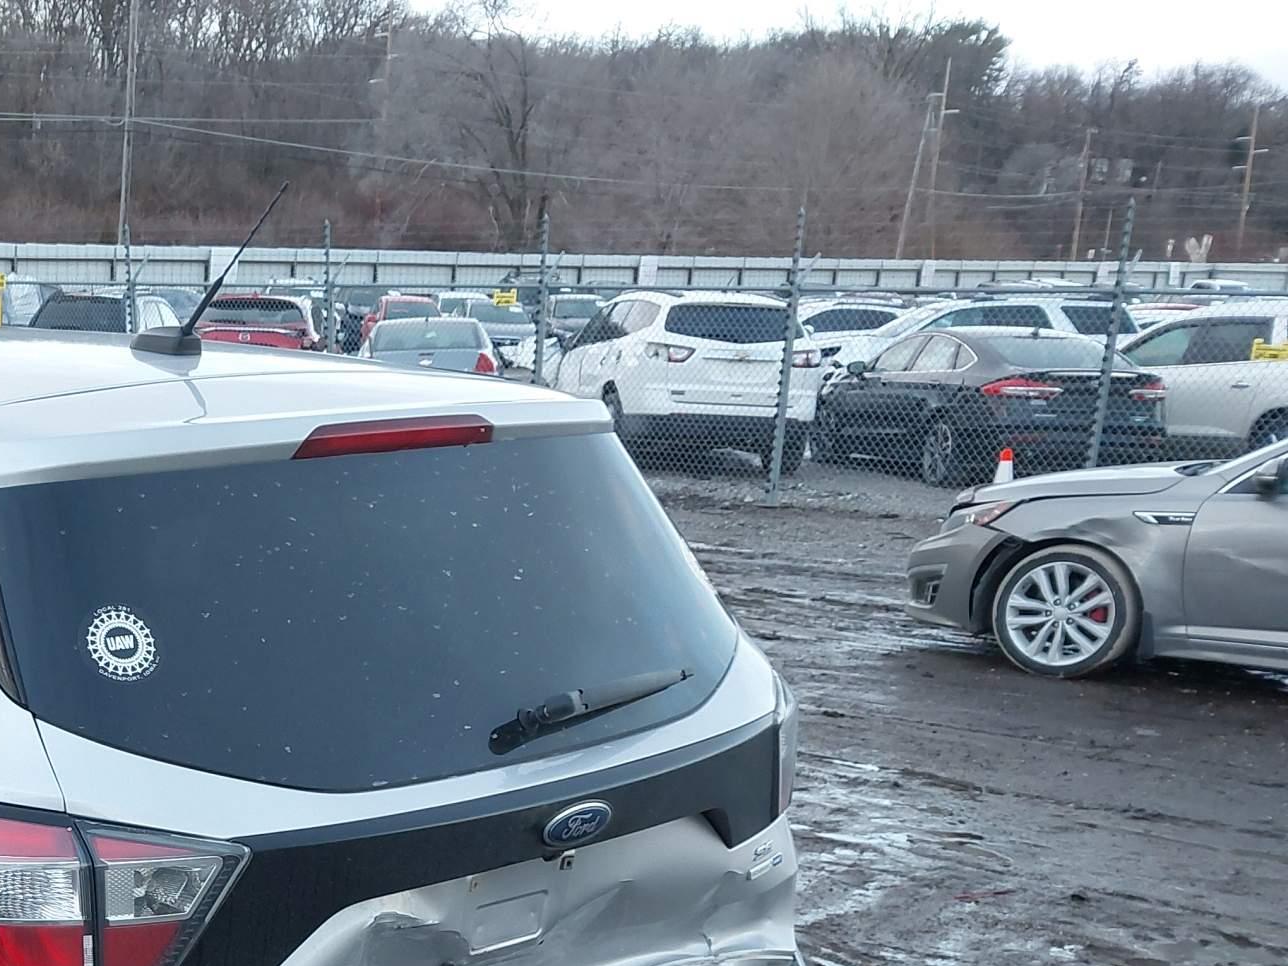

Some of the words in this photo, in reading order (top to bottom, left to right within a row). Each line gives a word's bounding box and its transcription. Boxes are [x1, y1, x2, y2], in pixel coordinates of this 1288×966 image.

[93, 605, 116, 616] LOCAL
[106, 635, 134, 651] UAW
[561, 813, 601, 839] Ford
